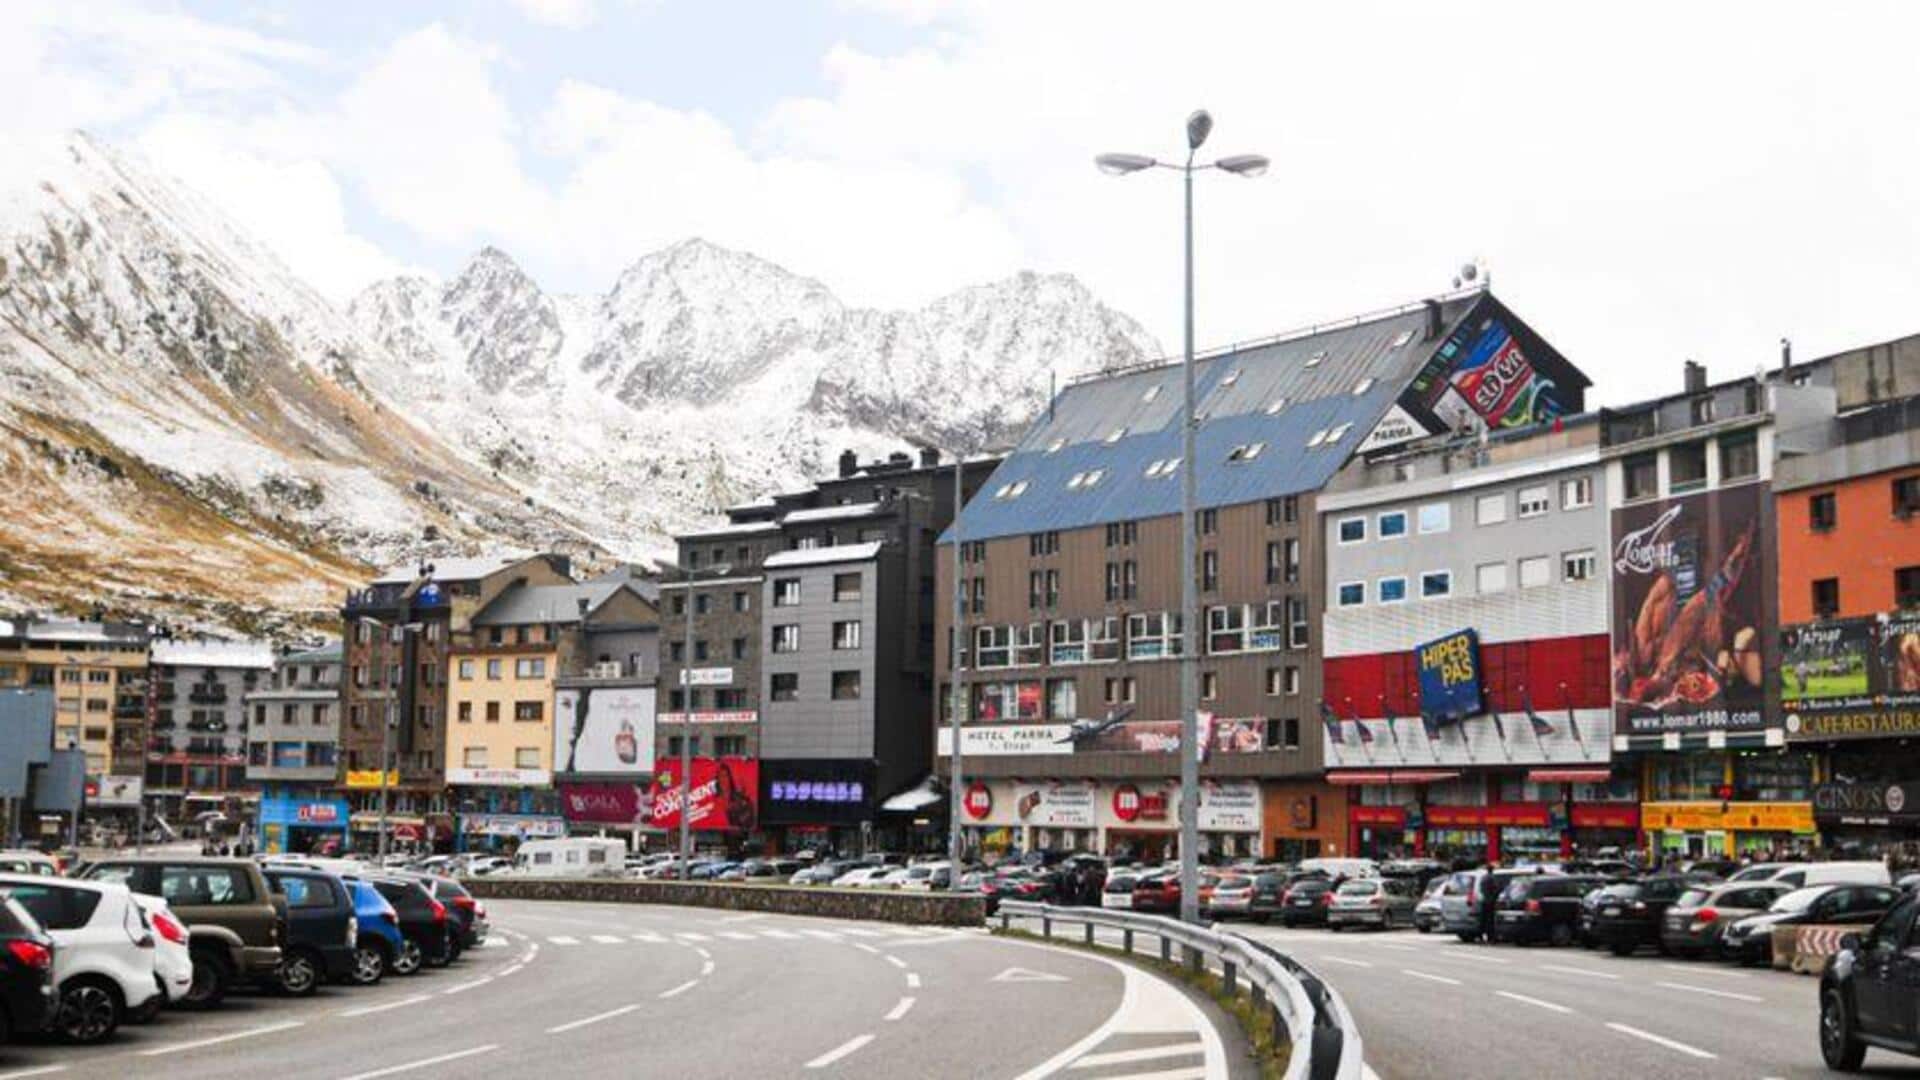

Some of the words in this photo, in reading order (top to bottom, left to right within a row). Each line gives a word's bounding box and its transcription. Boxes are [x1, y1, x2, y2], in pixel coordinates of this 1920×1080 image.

[1373, 426, 1413, 441] PARMA
[1422, 636, 1472, 671] HIPER
[1442, 660, 1474, 687] PAS
[1631, 709, 1760, 729] www.lomar1980.com
[968, 730, 1004, 741] HOTEL
[1013, 728, 1054, 739] PARMA
